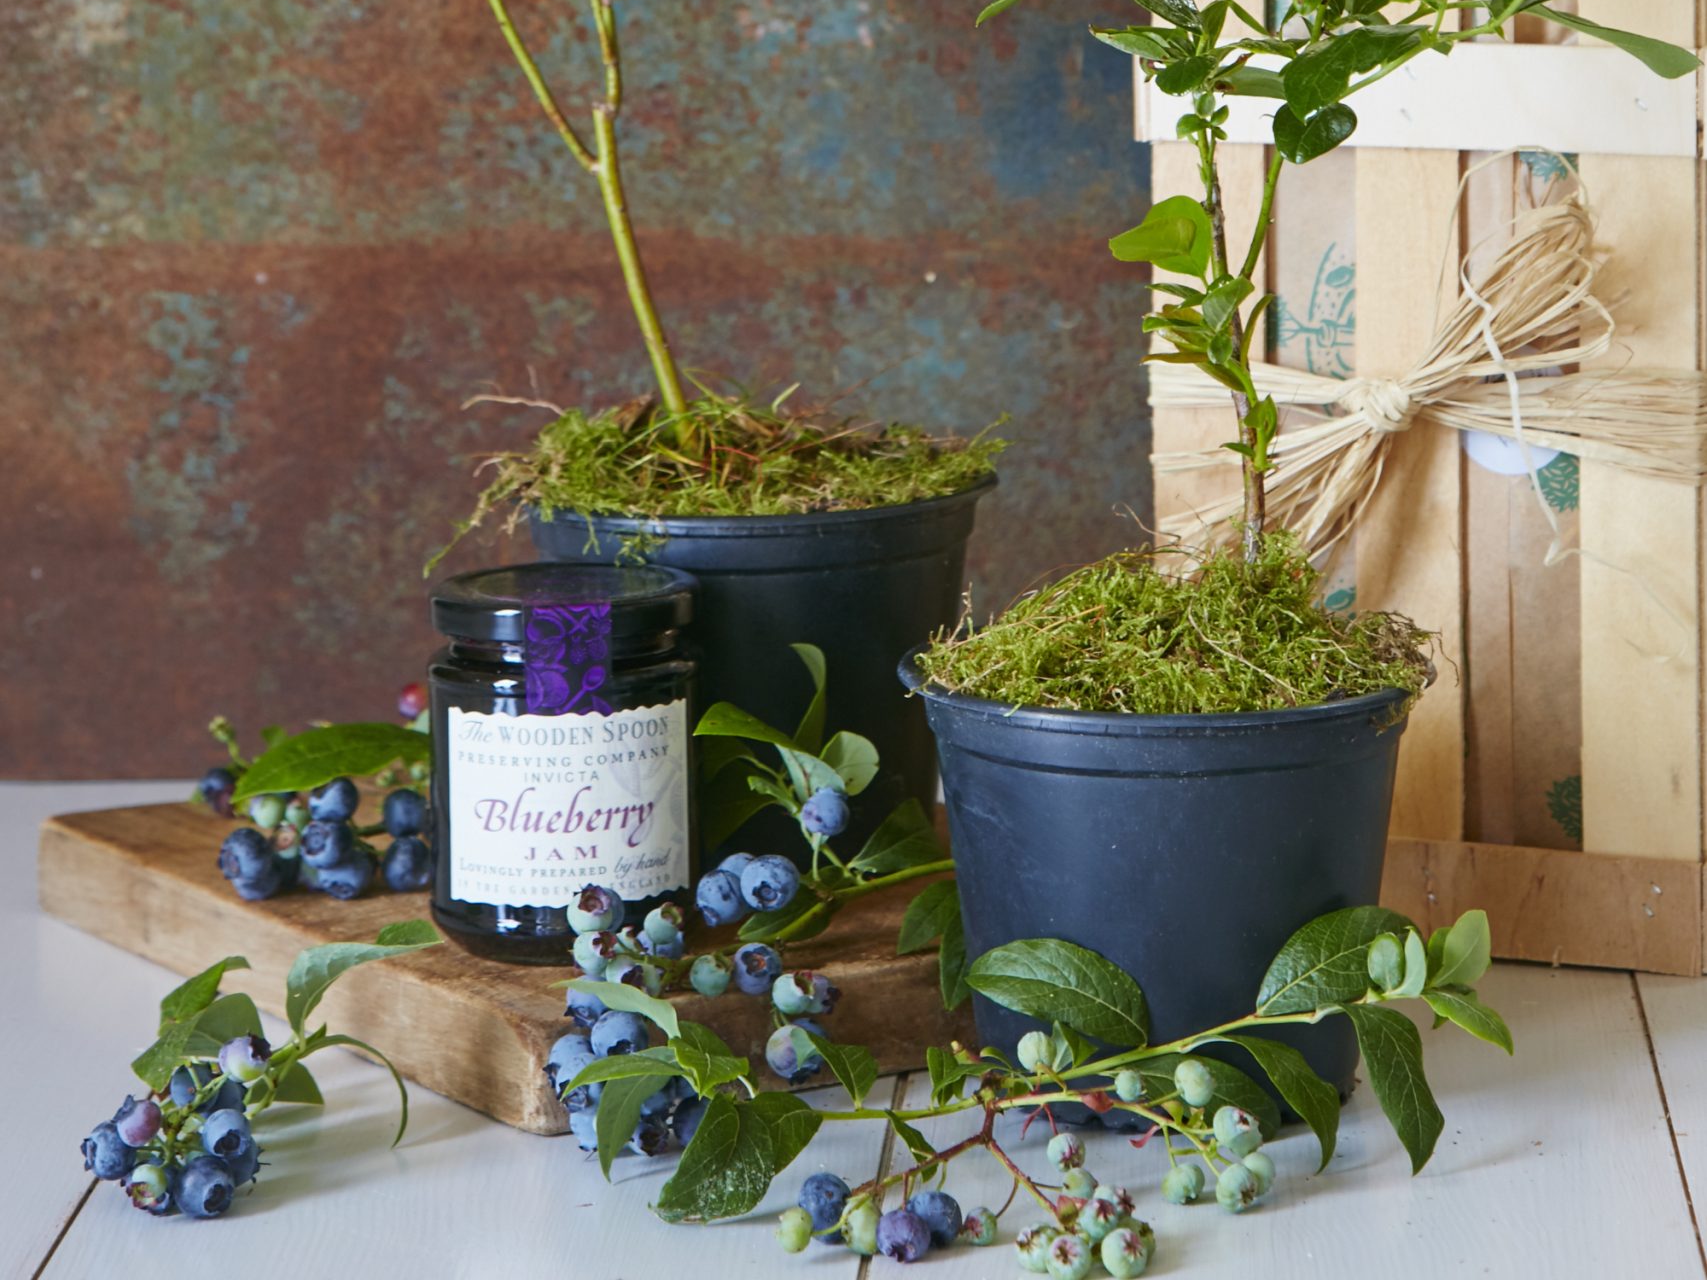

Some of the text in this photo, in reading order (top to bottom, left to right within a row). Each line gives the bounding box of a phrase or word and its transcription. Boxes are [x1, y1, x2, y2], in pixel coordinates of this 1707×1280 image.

[458, 715, 669, 746] The WOODEN SPOON
[458, 745, 671, 768] PRESERVING COMPANY
[523, 770, 600, 784] INVICTA
[474, 785, 654, 848] Blueberry
[459, 848, 672, 880] LOVINGLY PREPARED by hand
[524, 844, 599, 861] JAM
